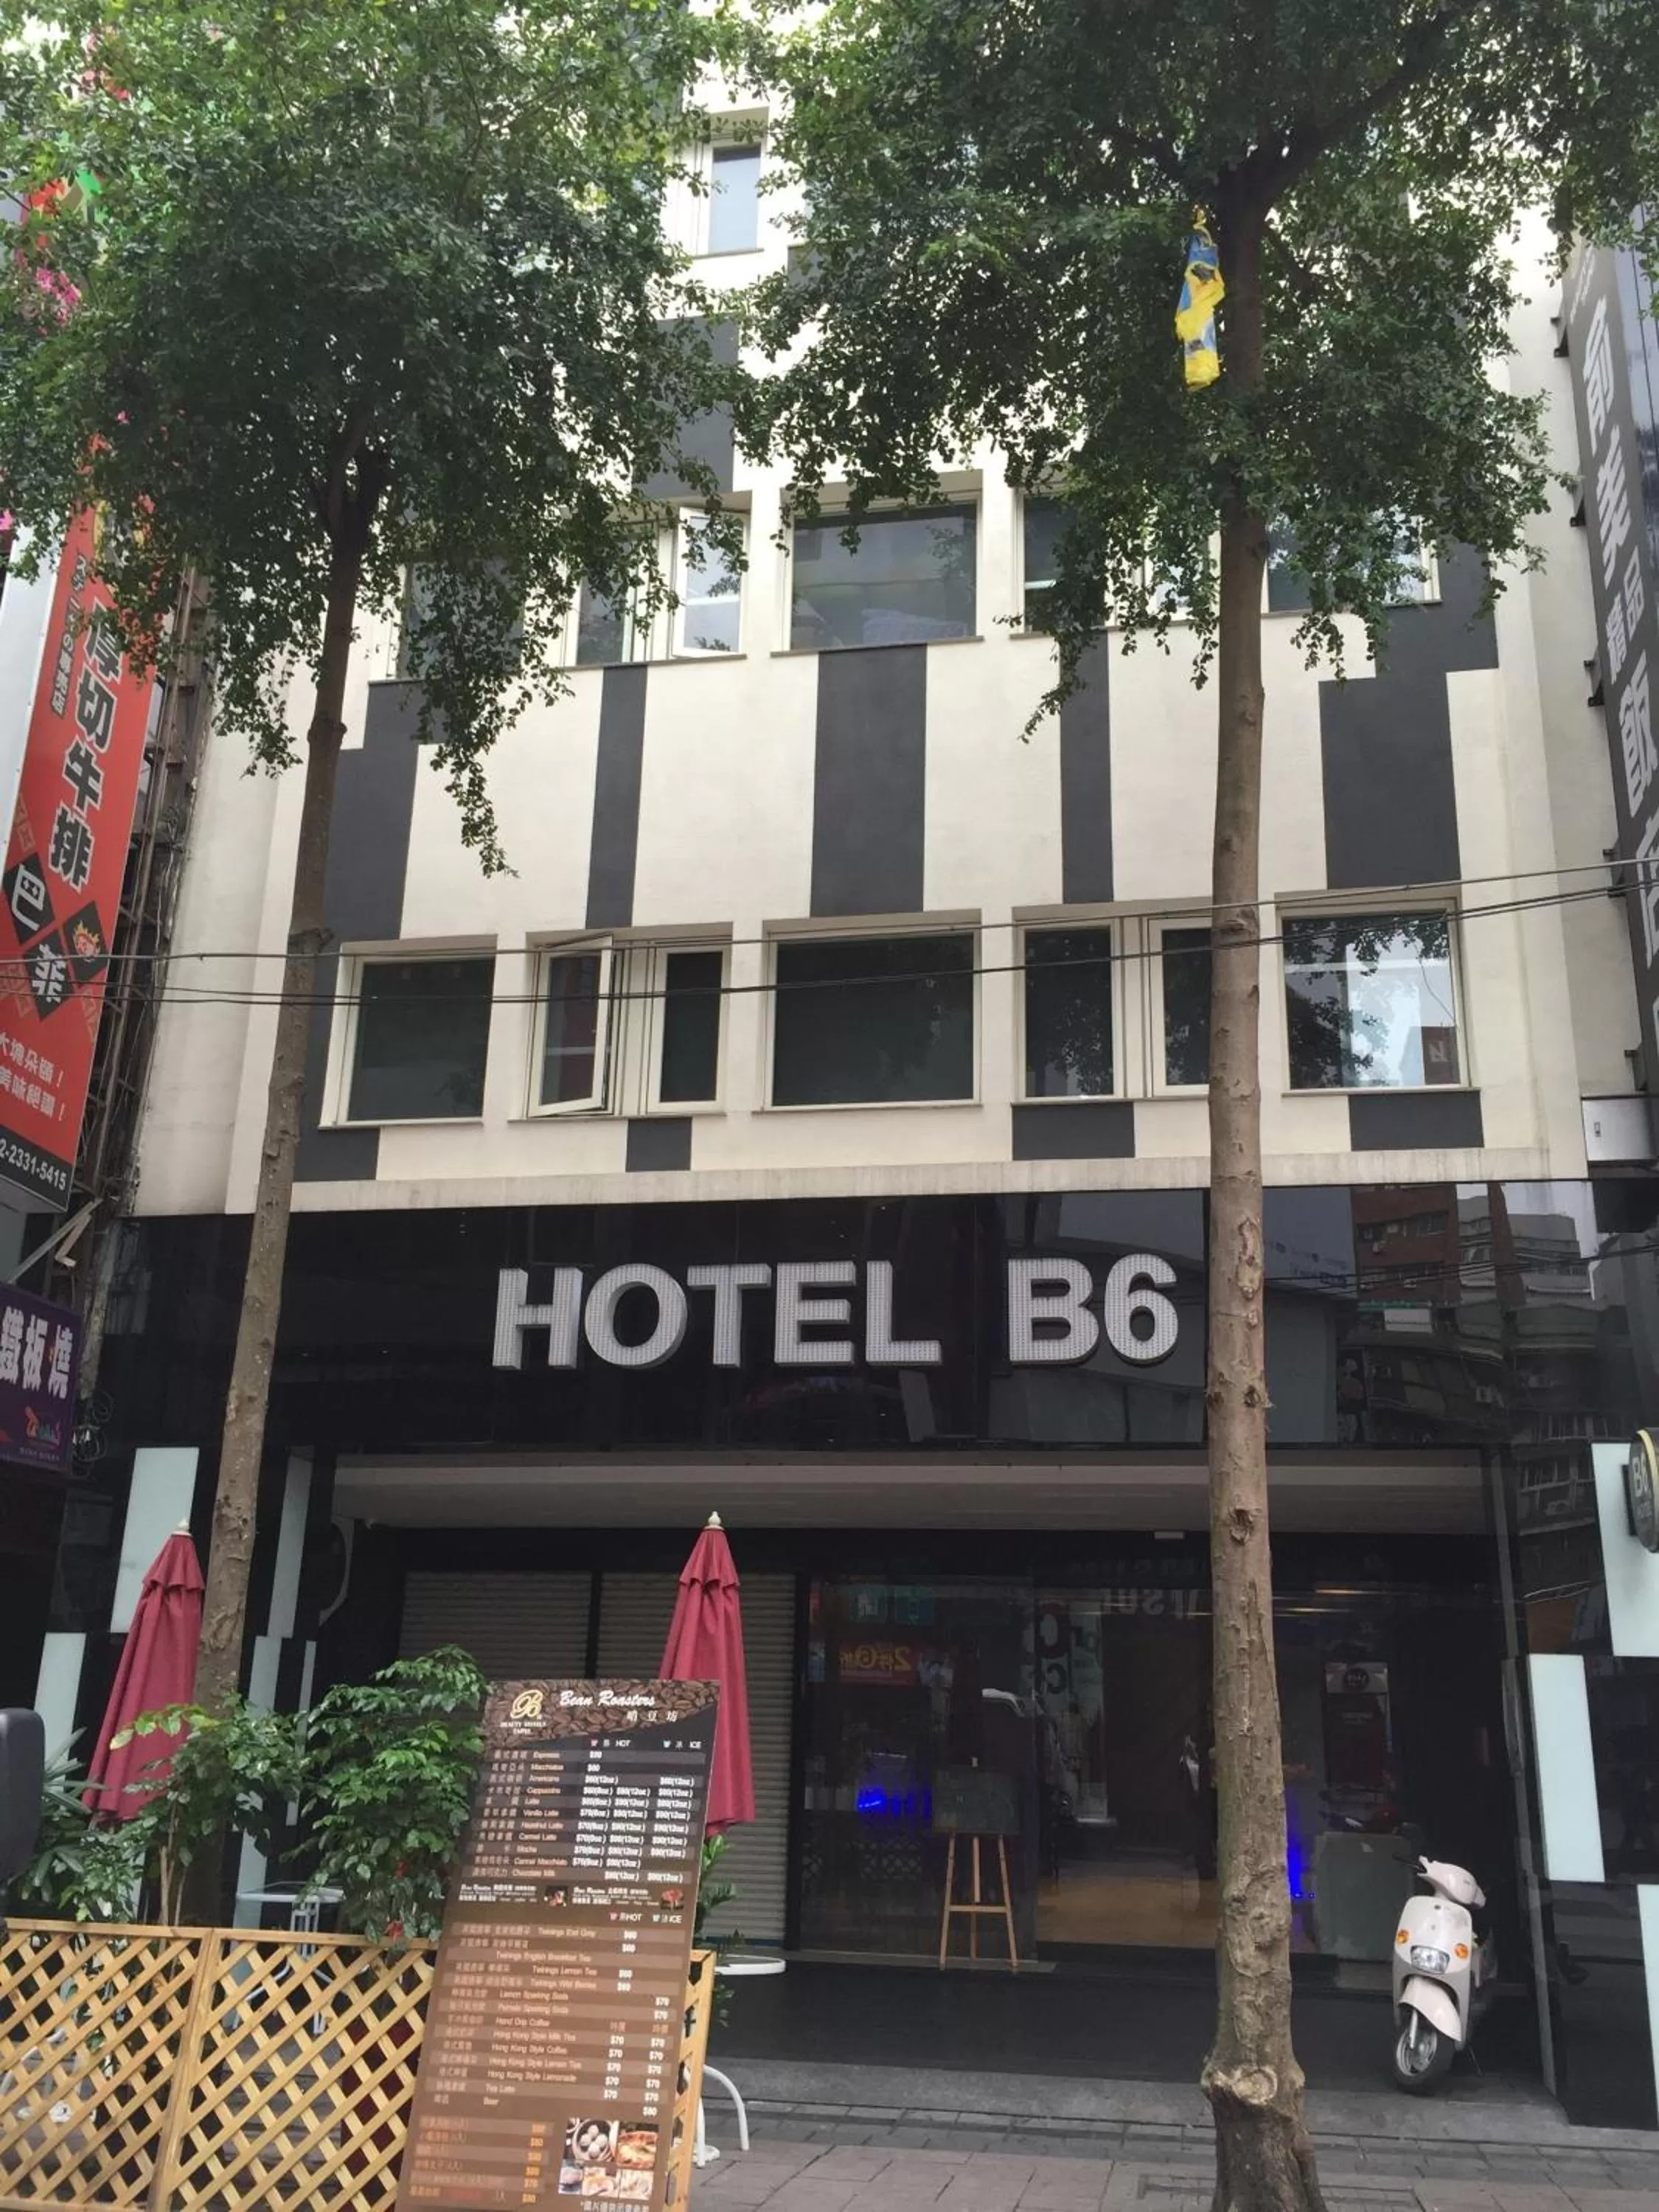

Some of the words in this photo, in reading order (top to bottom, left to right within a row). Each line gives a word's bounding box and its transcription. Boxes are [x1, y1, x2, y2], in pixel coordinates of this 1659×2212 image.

[492, 1261, 942, 1369] HOTEL
[1007, 1253, 1179, 1366] B6
[560, 1690, 593, 1706] Bean
[599, 1690, 655, 1707] Roasters
[627, 1913, 641, 1921] HOT
